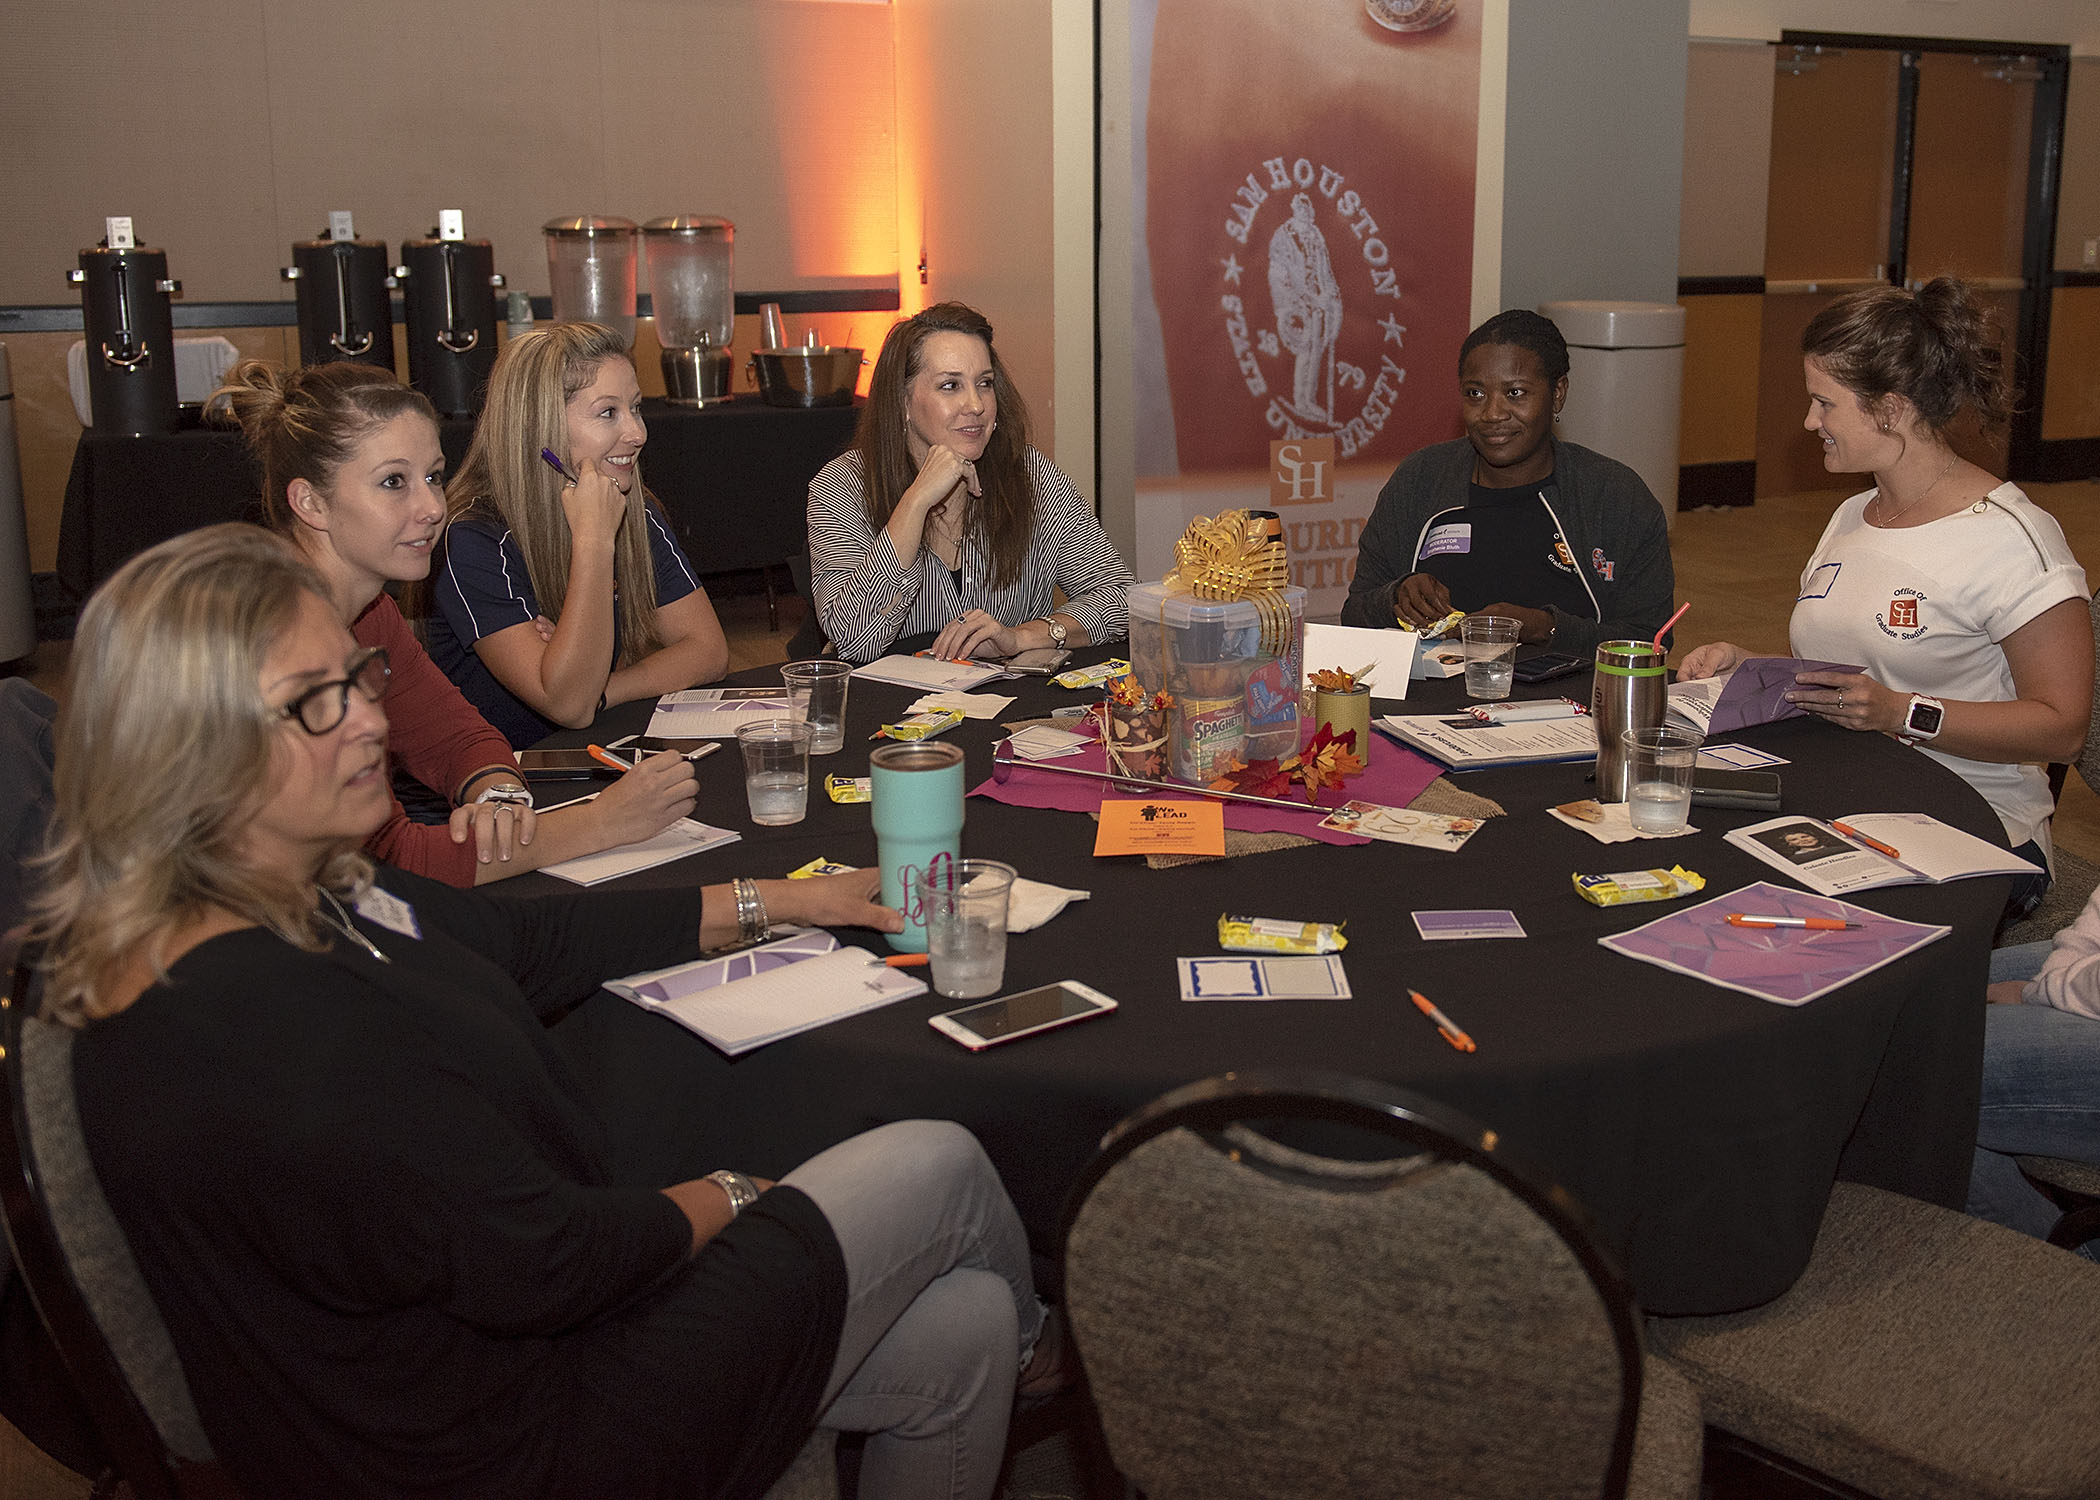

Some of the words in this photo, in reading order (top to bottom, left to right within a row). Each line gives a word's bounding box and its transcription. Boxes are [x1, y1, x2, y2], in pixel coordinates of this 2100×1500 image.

[1225, 173, 1268, 244] SAM
[1263, 157, 1401, 299] HOUSTON
[1265, 354, 1406, 457] UNERSITY
[1277, 445, 1327, 500] SH
[1892, 601, 1916, 625] SH
[1893, 588, 1916, 596] Office
[1916, 592, 1928, 601] Of
[1875, 613, 1898, 638] Graduate
[1901, 625, 1929, 640] Studies
